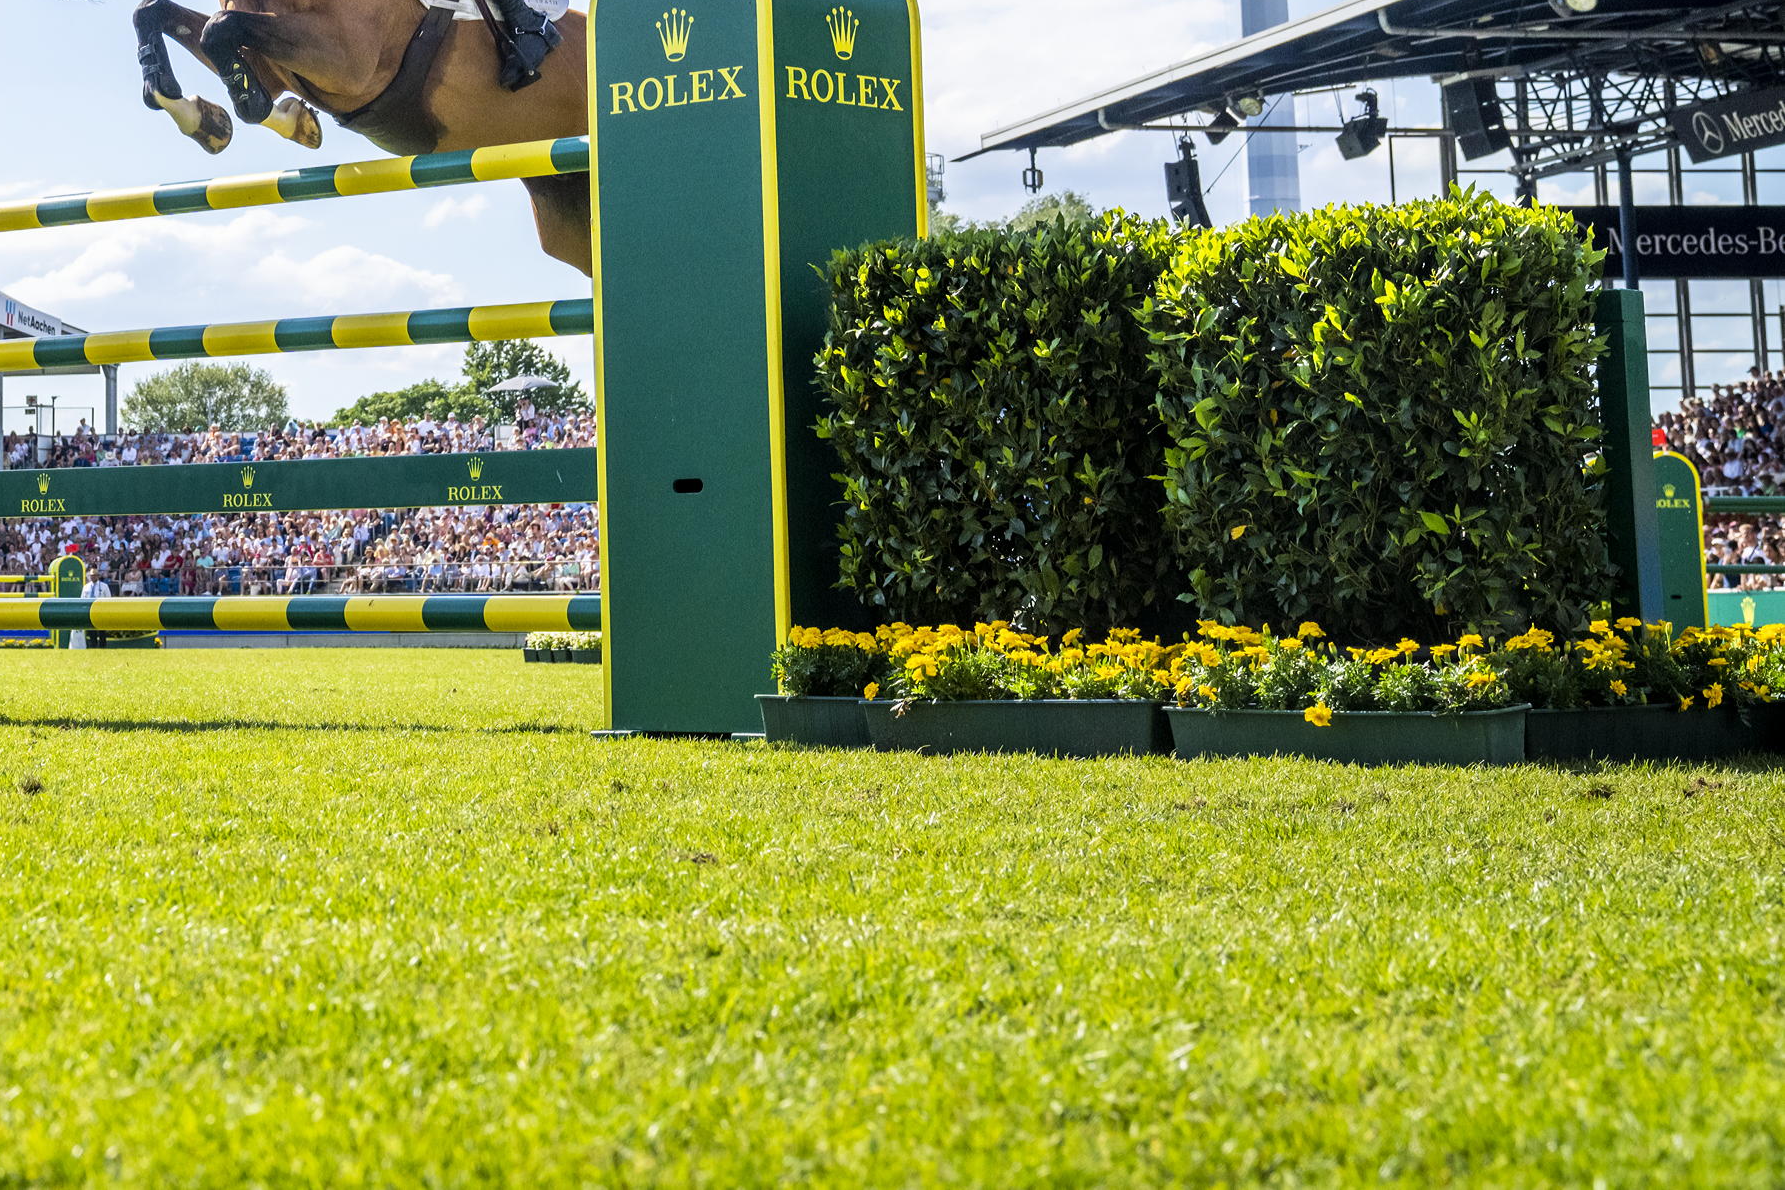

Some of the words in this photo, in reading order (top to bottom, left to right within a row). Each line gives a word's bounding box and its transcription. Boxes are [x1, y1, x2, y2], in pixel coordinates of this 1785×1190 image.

[609, 66, 747, 115] ROLEX
[785, 65, 904, 112] ROLEX
[18, 310, 56, 336] NetAachen
[222, 493, 273, 508] ROLEX
[448, 485, 503, 501] ROLEX
[21, 498, 66, 513] ROLEX
